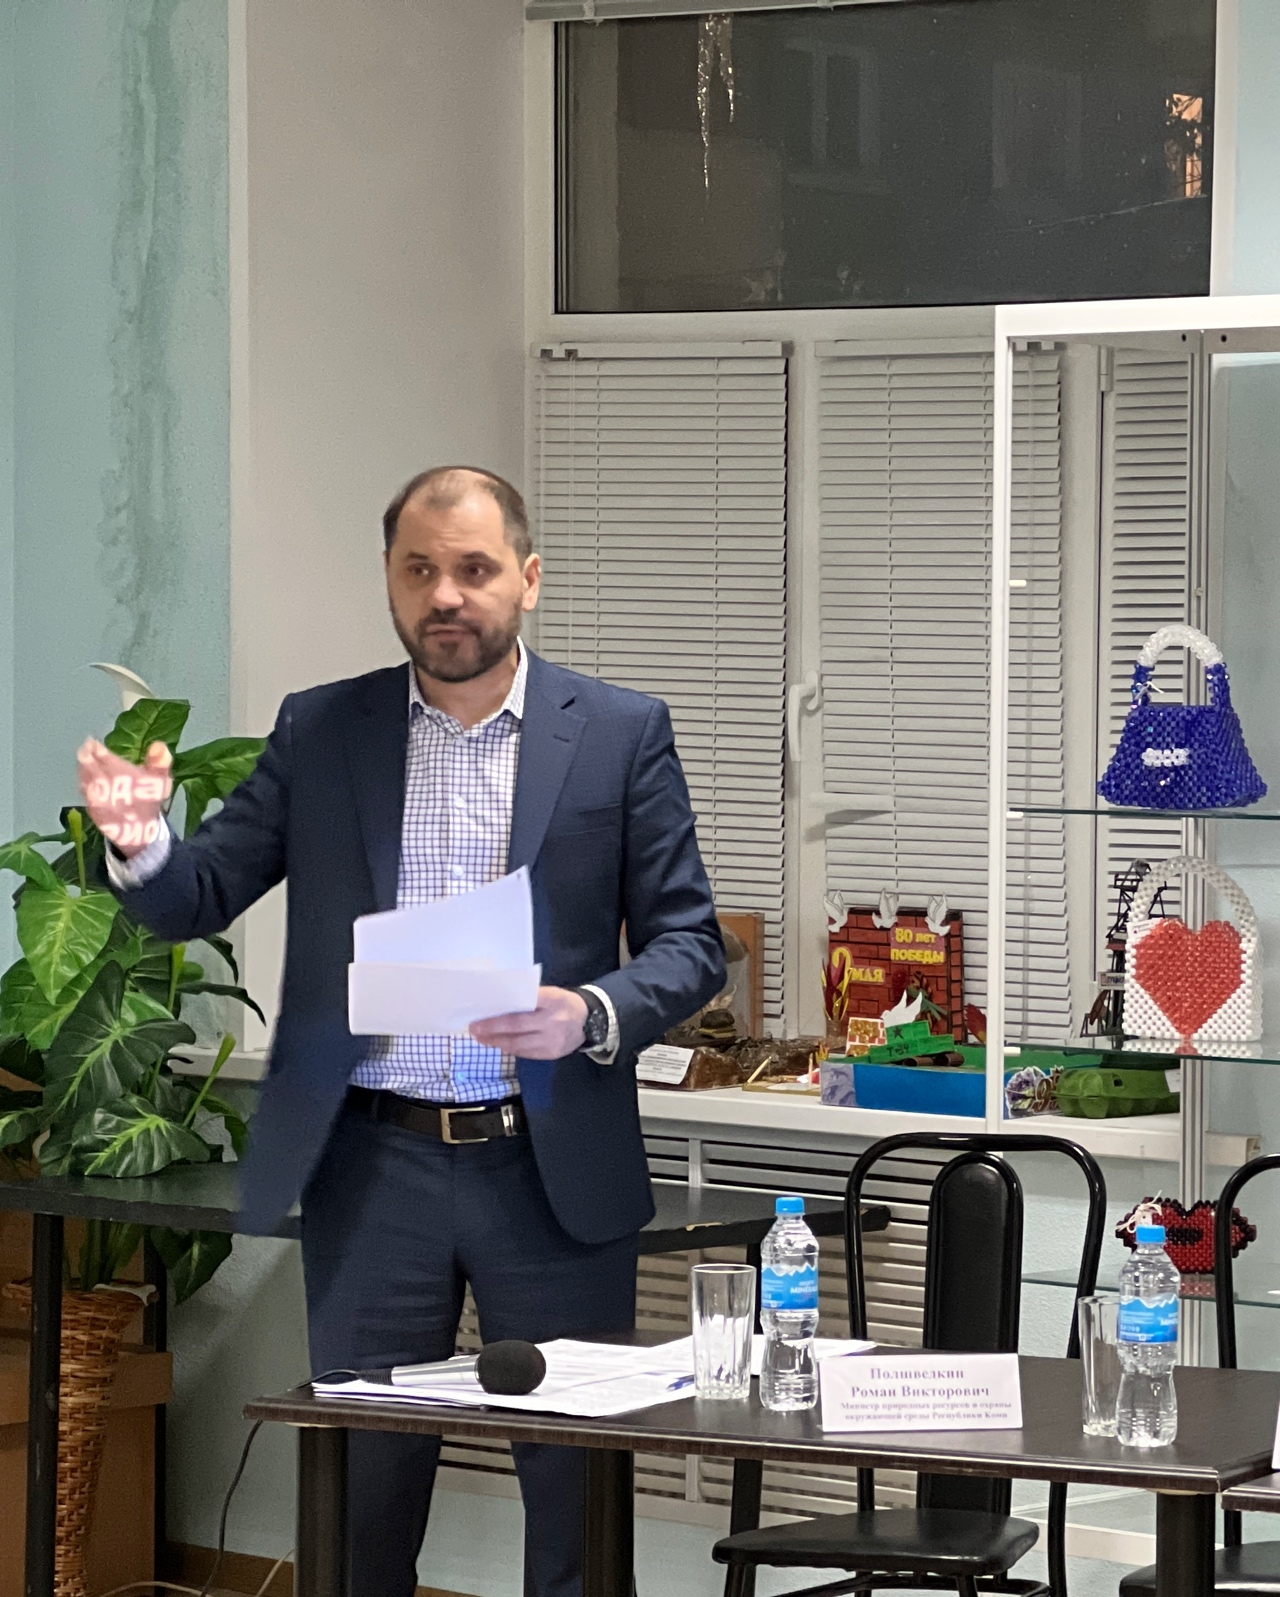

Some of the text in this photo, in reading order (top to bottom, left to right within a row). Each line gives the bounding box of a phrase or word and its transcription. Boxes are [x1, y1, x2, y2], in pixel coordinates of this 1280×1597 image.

[890, 948, 944, 965] ПОБЕДЫ
[851, 967, 885, 983] МАЯ
[851, 1384, 989, 1399] Роман Викторович
